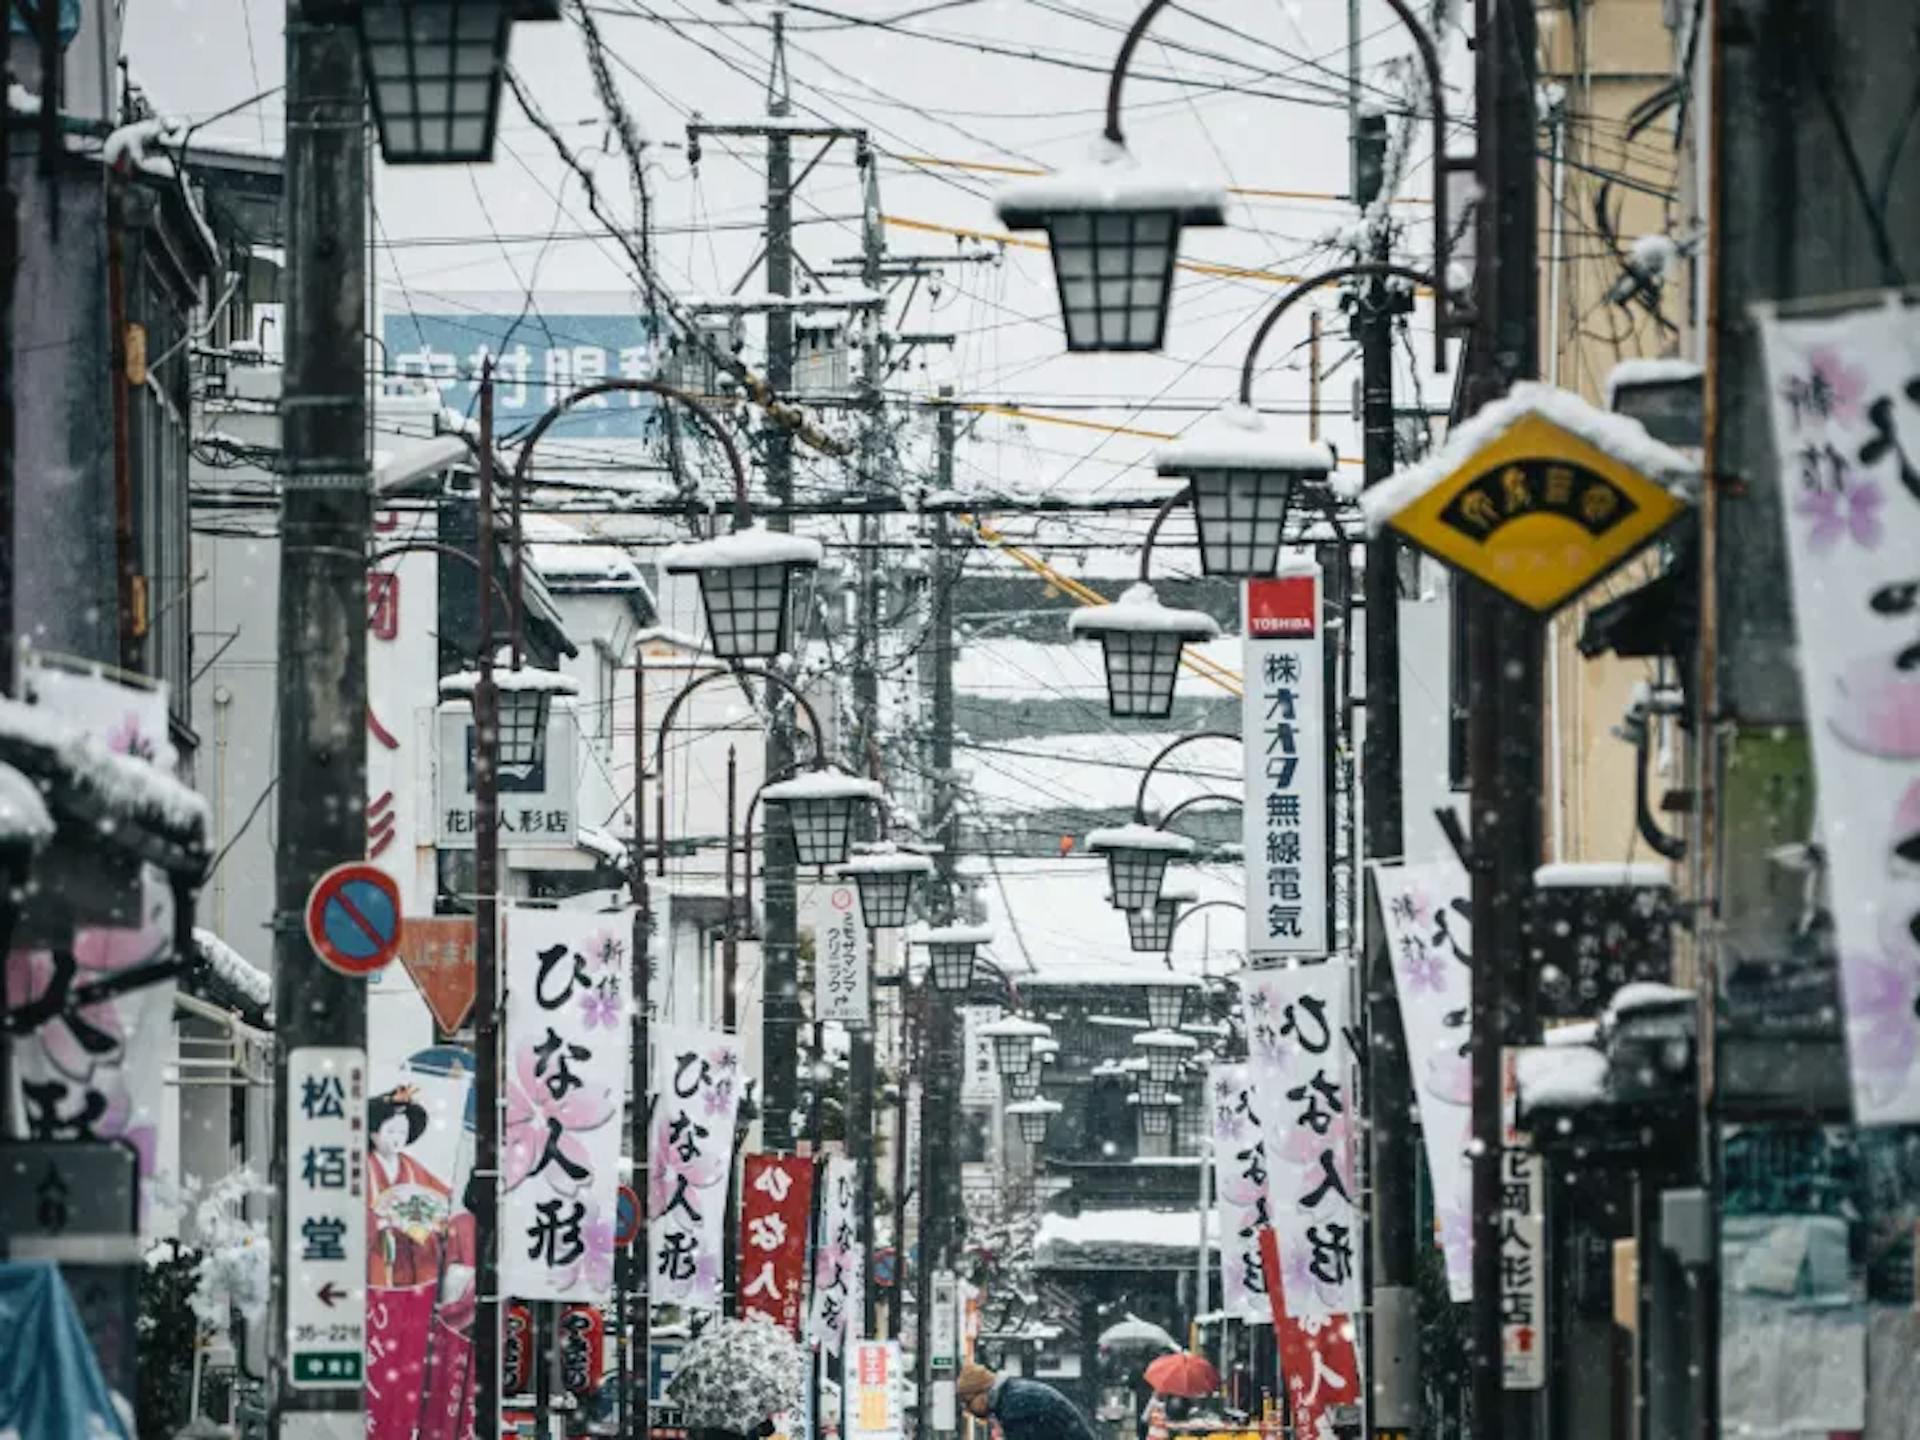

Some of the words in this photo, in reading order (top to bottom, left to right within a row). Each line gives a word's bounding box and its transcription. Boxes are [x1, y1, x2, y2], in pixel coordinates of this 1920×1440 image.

[1253, 617, 1312, 631] TOSHIBA
[446, 808, 568, 833] 花人形店
[526, 943, 593, 1267] ひな人形
[658, 1051, 713, 1281] ひな人形
